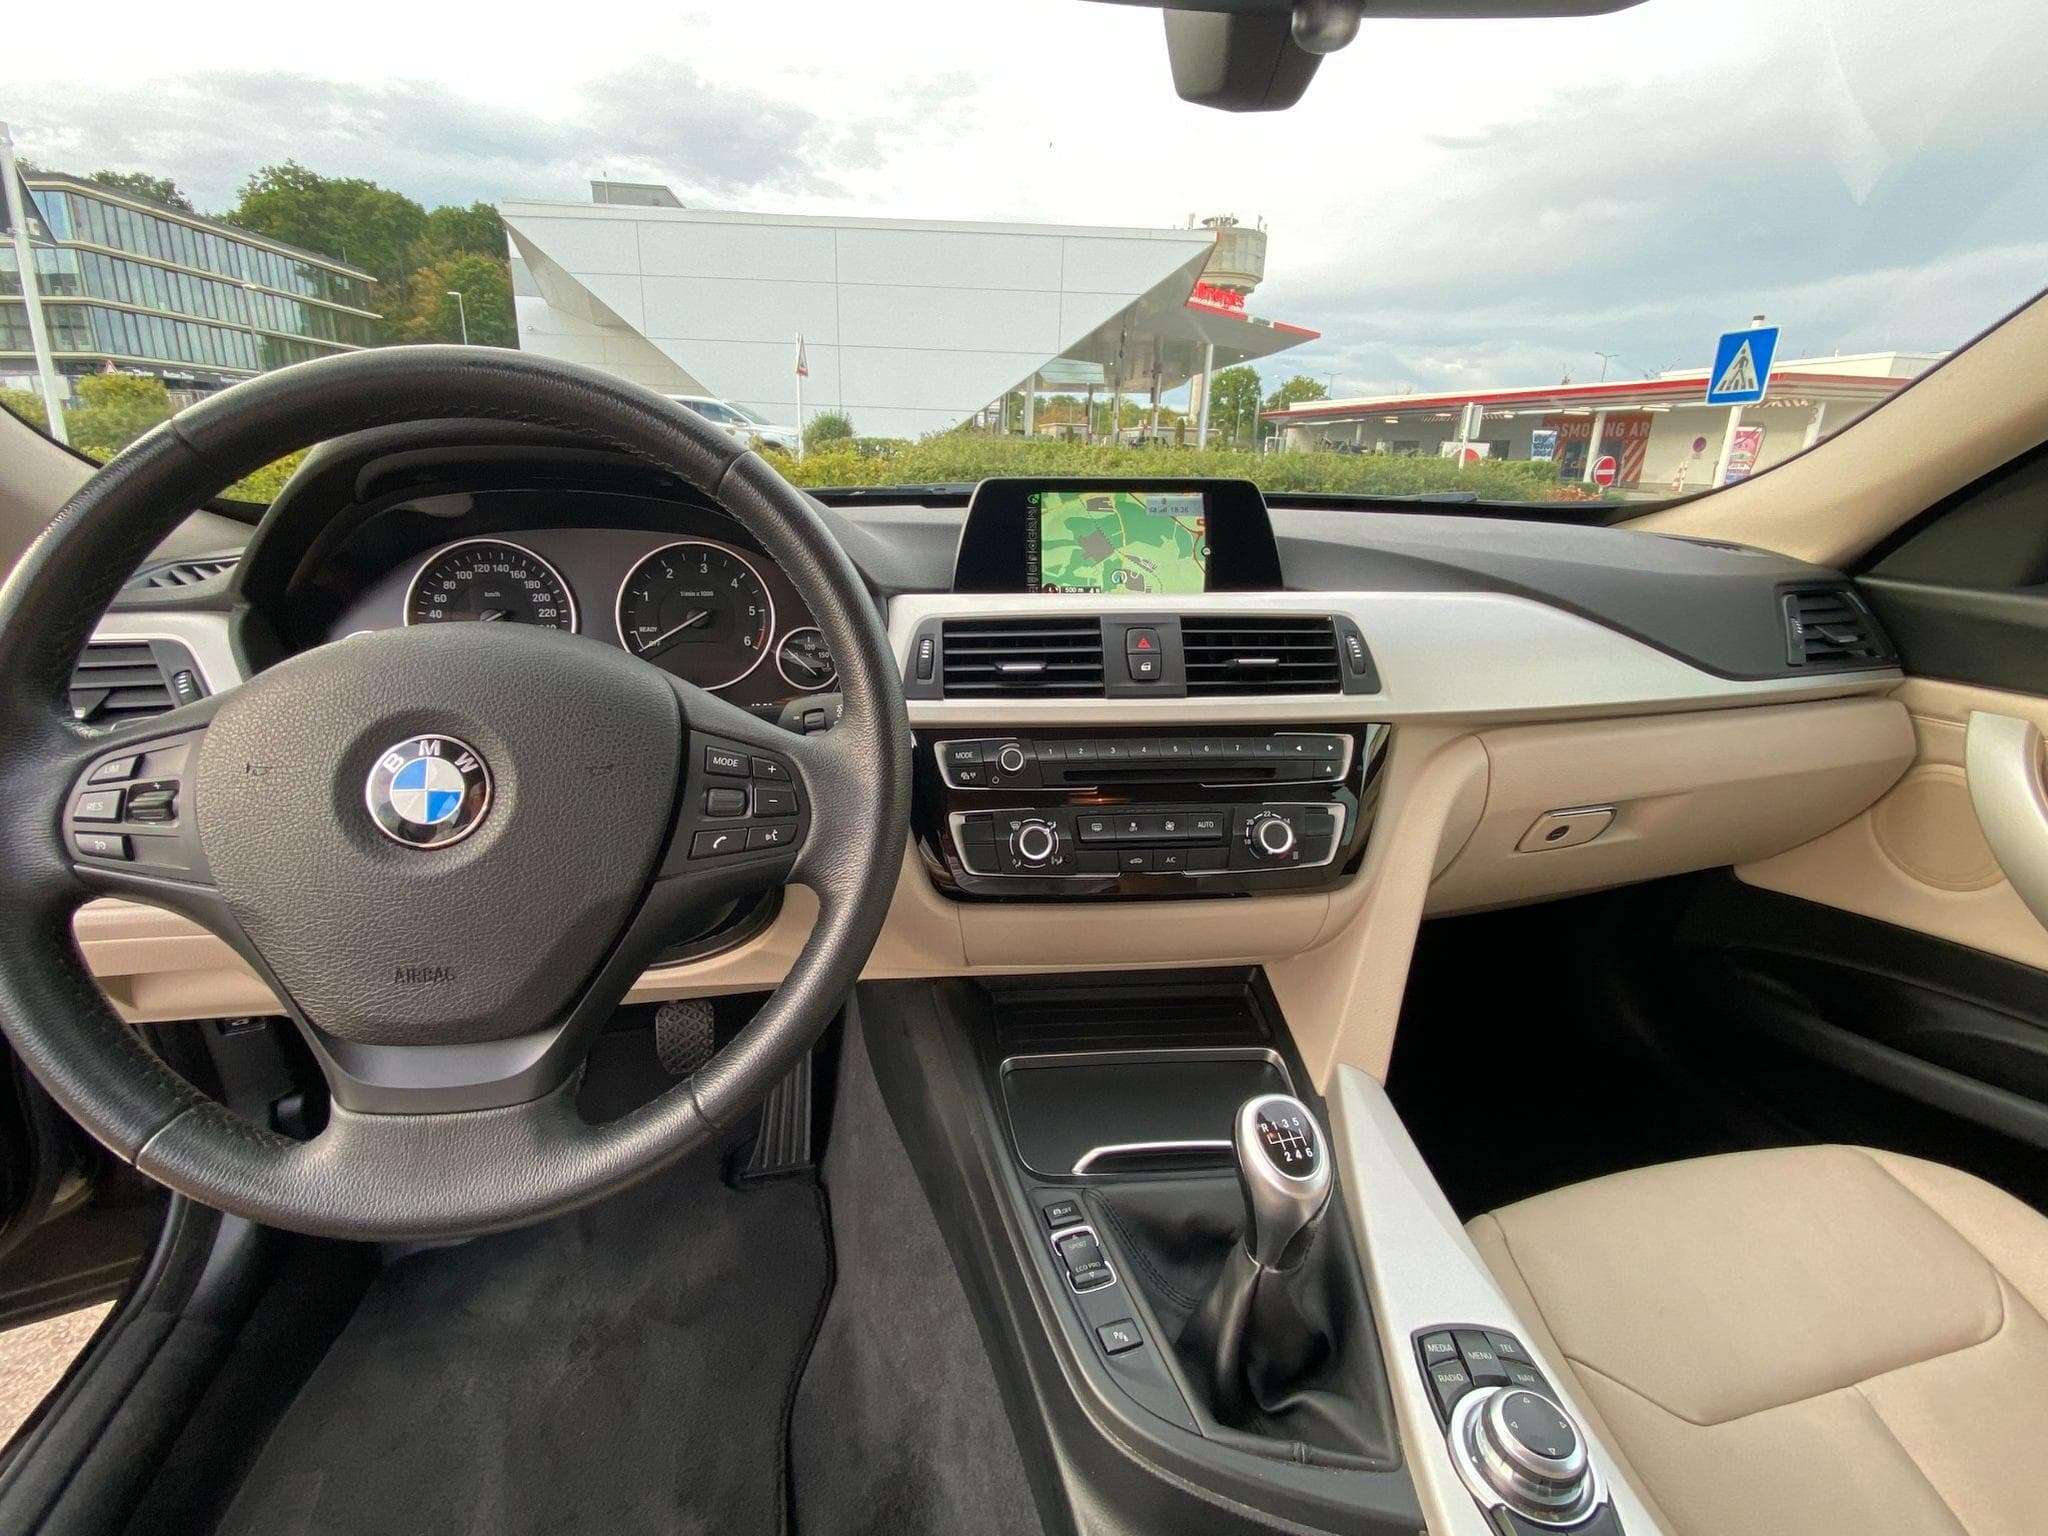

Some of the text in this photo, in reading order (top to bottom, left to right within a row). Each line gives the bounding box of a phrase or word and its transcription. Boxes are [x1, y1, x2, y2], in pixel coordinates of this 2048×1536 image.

[1560, 422, 1625, 438] SMONG
[473, 564, 490, 573] 120
[492, 564, 509, 573] 140
[700, 563, 708, 574] 3
[456, 571, 472, 579] 100
[510, 570, 527, 579] 160
[666, 568, 674, 579] 2
[443, 581, 456, 590] 80
[524, 580, 541, 589] 180
[731, 578, 739, 589] 4
[433, 594, 447, 603] 60
[532, 593, 551, 602] 200
[643, 590, 649, 601] 1
[429, 609, 442, 618] 40
[538, 608, 557, 617] 220
[749, 605, 756, 616] 5
[744, 635, 751, 646] 6
[804, 643, 816, 651] 100
[382, 739, 480, 774] BMW
[955, 751, 973, 759] MODE
[712, 756, 739, 767] MODE
[1260, 1117, 1300, 1133] R 1 3 5
[1284, 1147, 1313, 1162] 2 4 6
[1427, 1343, 1454, 1352] MEDIA
[1500, 1343, 1515, 1352] TEL
[1467, 1351, 1493, 1360] MENU
[1437, 1373, 1464, 1382] RADIO
